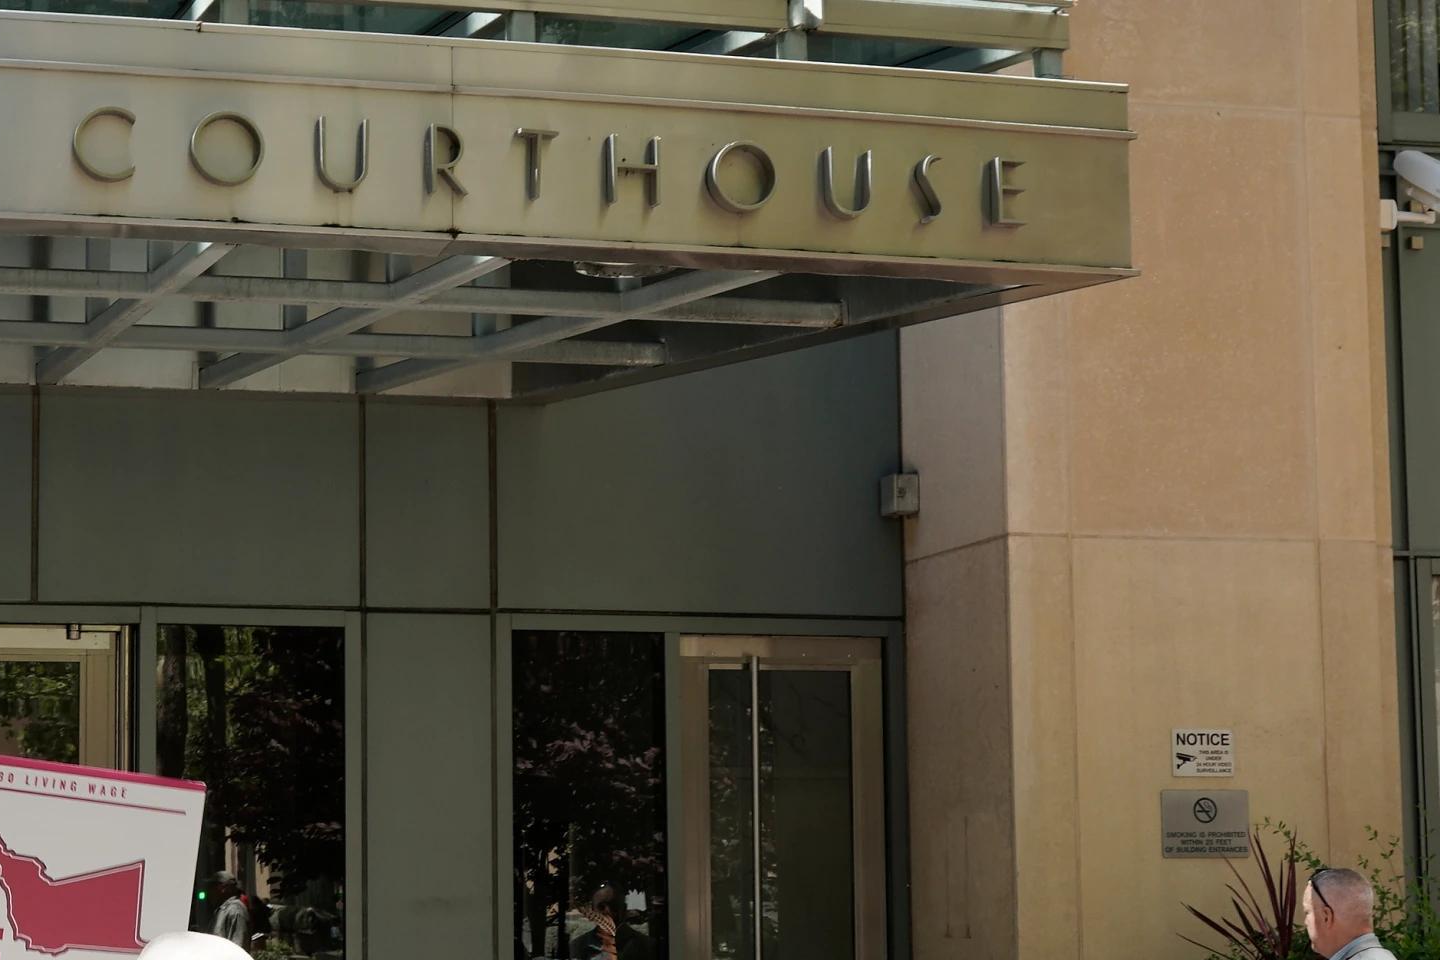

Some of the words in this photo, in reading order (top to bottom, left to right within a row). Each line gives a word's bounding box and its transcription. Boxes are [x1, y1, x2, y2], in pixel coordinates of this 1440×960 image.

[71, 105, 1028, 229] COURTHOUSE
[1176, 733, 1230, 746] NOTICE
[25, 775, 77, 792] LIVING
[88, 783, 128, 799] WAGE
